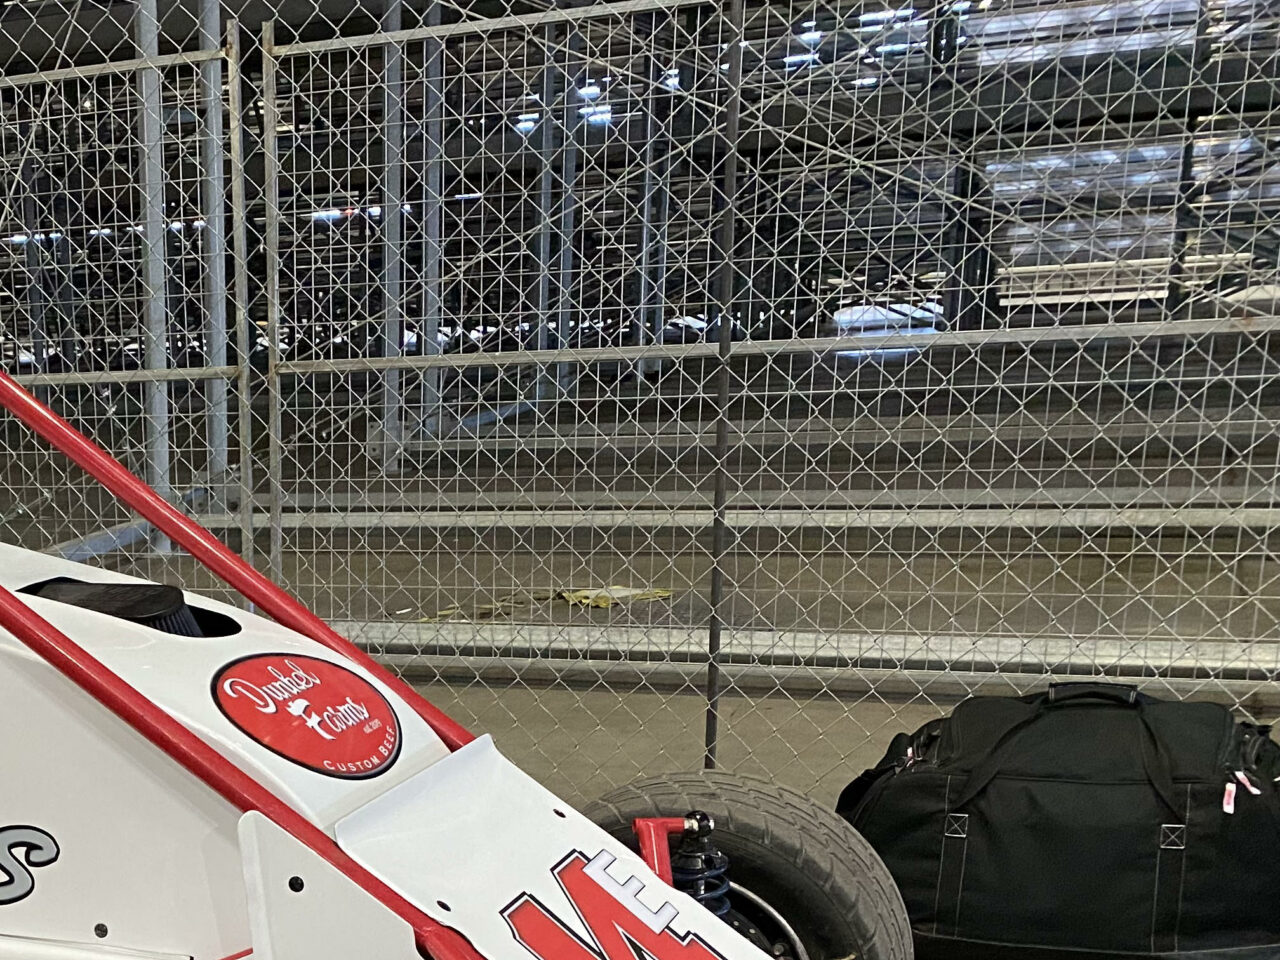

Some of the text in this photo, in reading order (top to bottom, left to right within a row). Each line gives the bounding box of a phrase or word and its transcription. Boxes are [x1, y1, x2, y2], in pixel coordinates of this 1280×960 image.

[223, 659, 321, 713] Dunkel
[286, 698, 370, 740] Farms
[323, 725, 396, 772] CUSTOM BEEF
